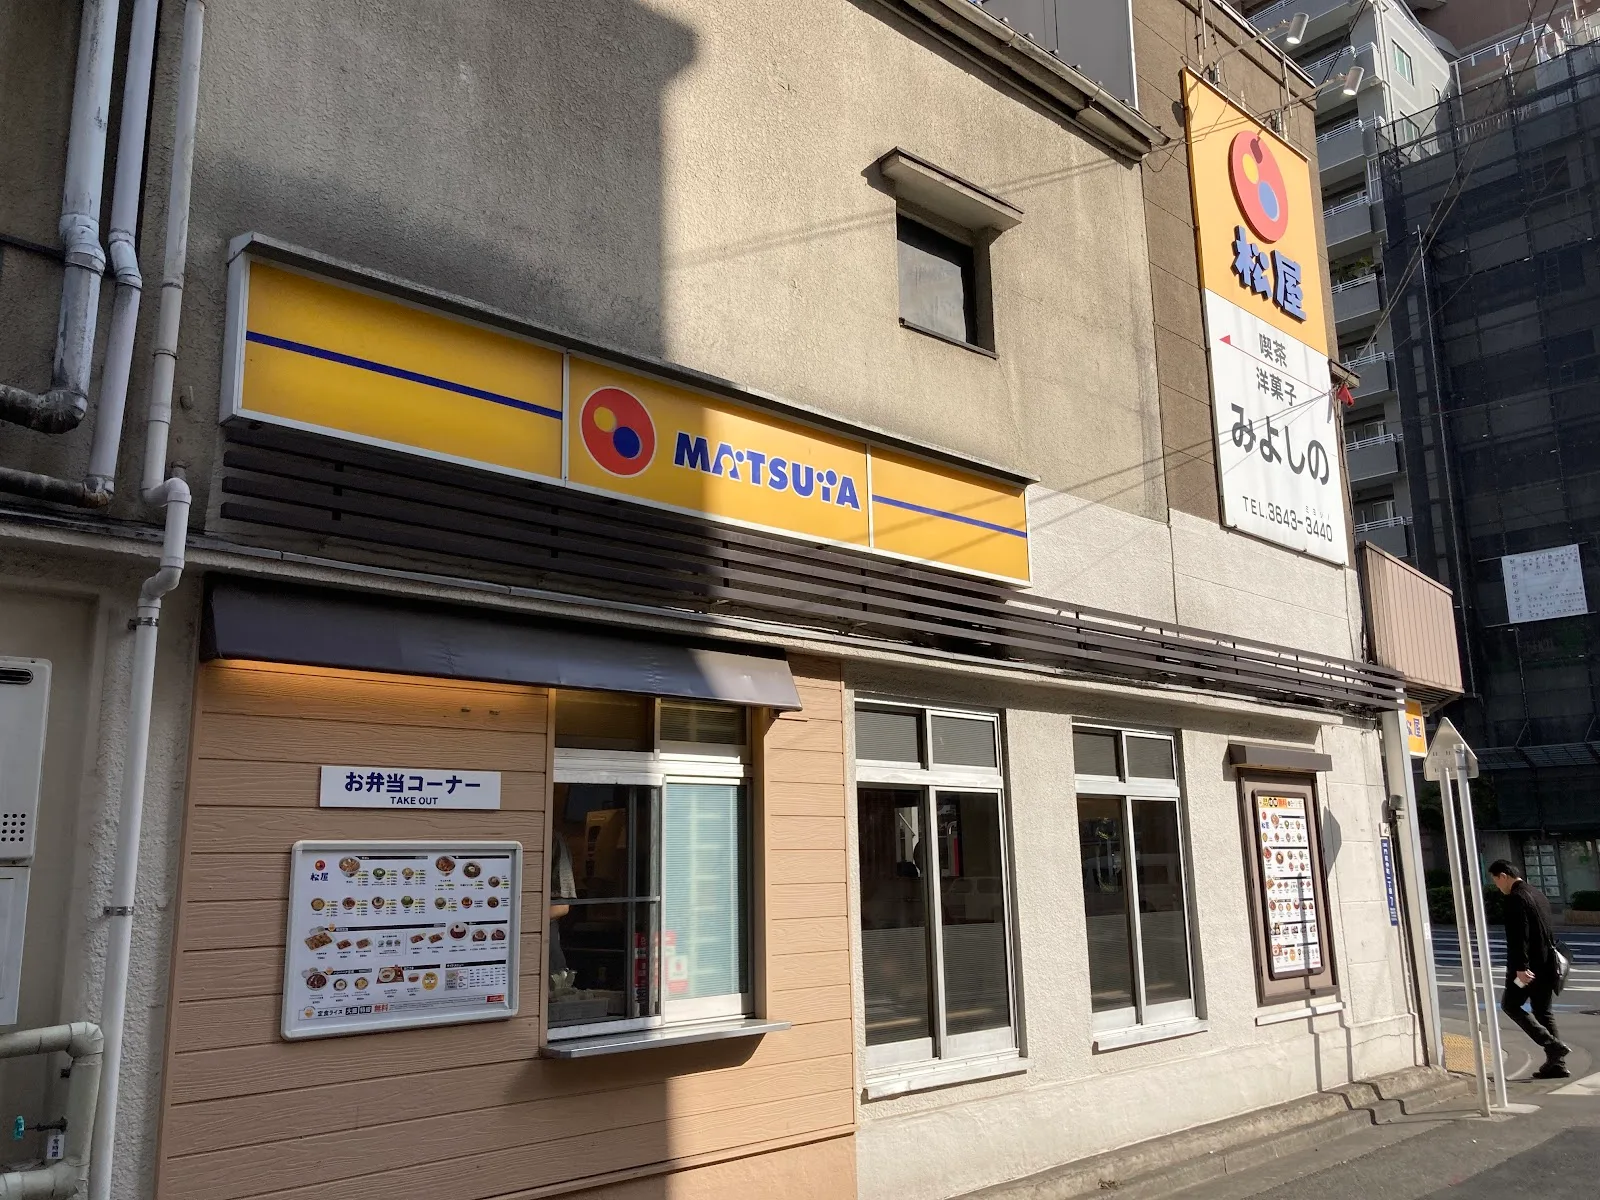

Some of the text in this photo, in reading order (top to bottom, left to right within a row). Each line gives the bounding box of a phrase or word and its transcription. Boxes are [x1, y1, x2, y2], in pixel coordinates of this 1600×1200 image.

[1231, 225, 1306, 323] 松屋
[1258, 333, 1288, 368] 喫茶
[1256, 366, 1297, 406] 洋菓子
[1230, 402, 1330, 485] みよしの
[673, 431, 860, 510] MATSUYA
[344, 771, 481, 794] お弁当コーナー
[390, 796, 439, 805] TAKE OUT
[310, 872, 329, 882] 松屋
